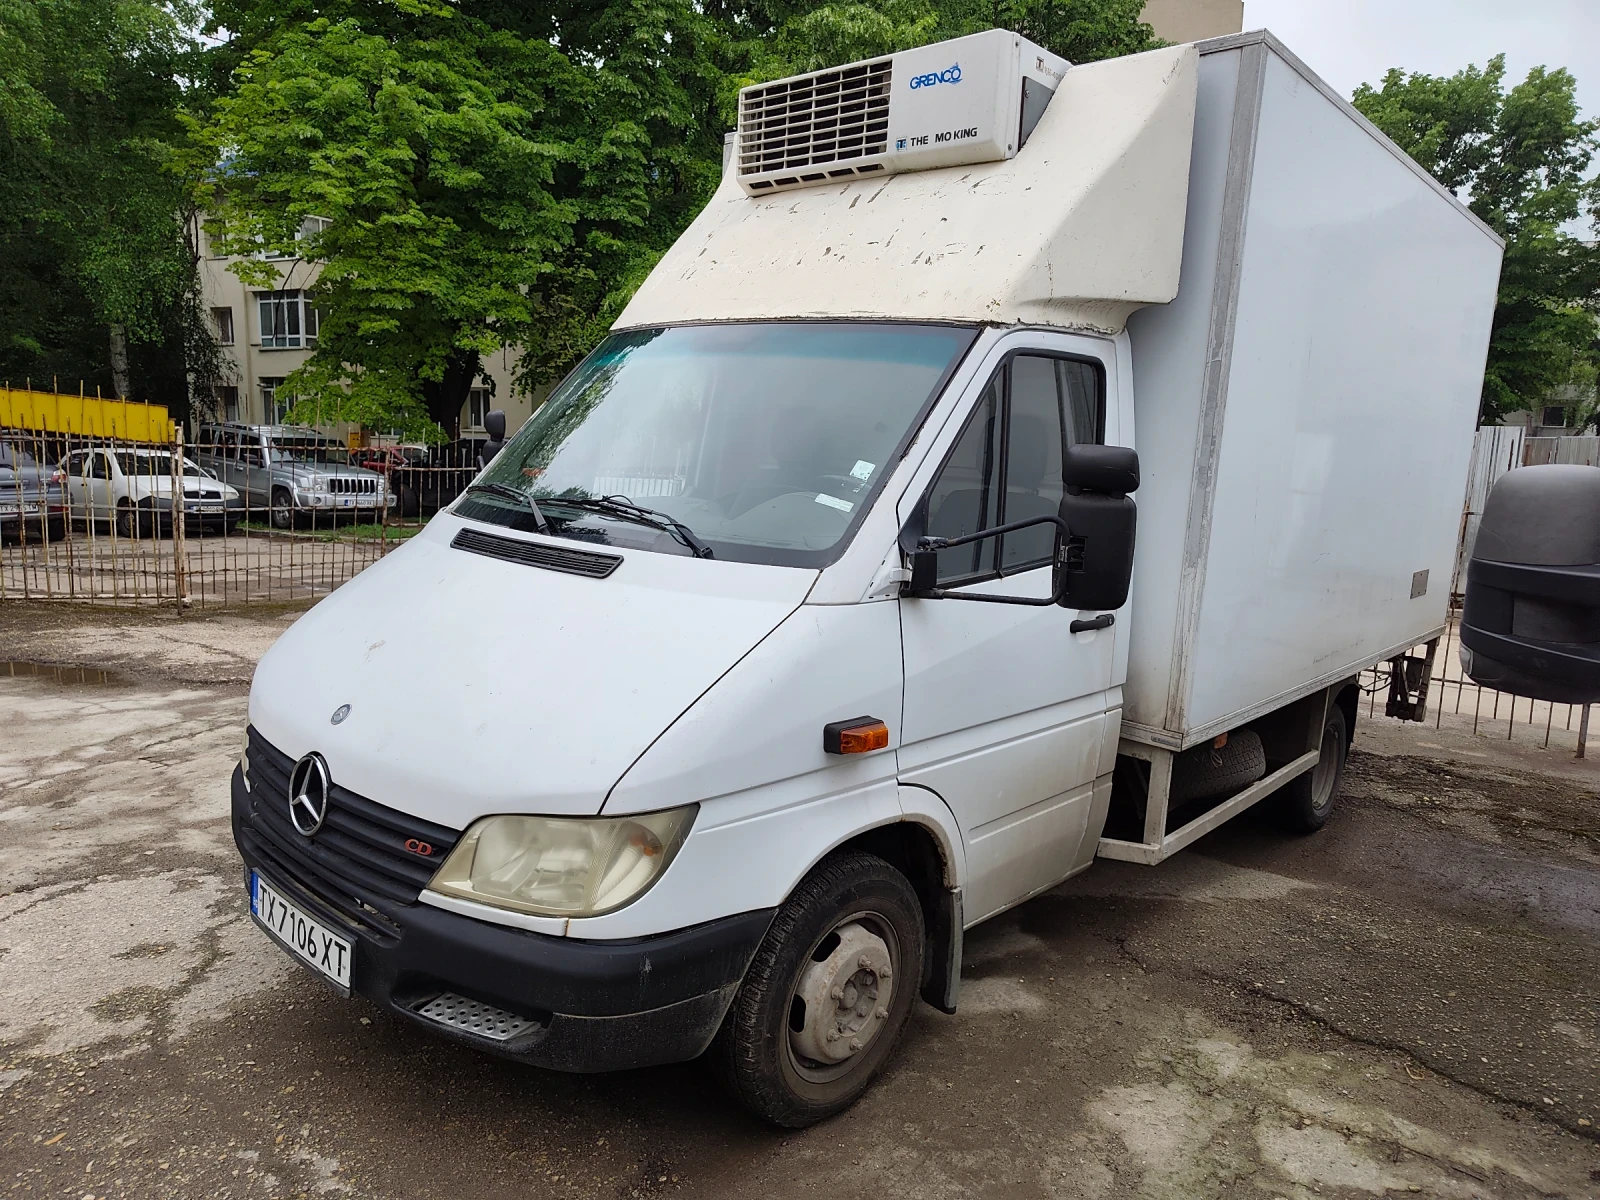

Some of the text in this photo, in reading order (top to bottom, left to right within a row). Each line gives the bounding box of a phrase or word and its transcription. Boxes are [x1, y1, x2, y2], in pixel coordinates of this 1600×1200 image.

[910, 66, 962, 89] GRENCO
[911, 136, 929, 146] THE
[954, 127, 978, 140] KING
